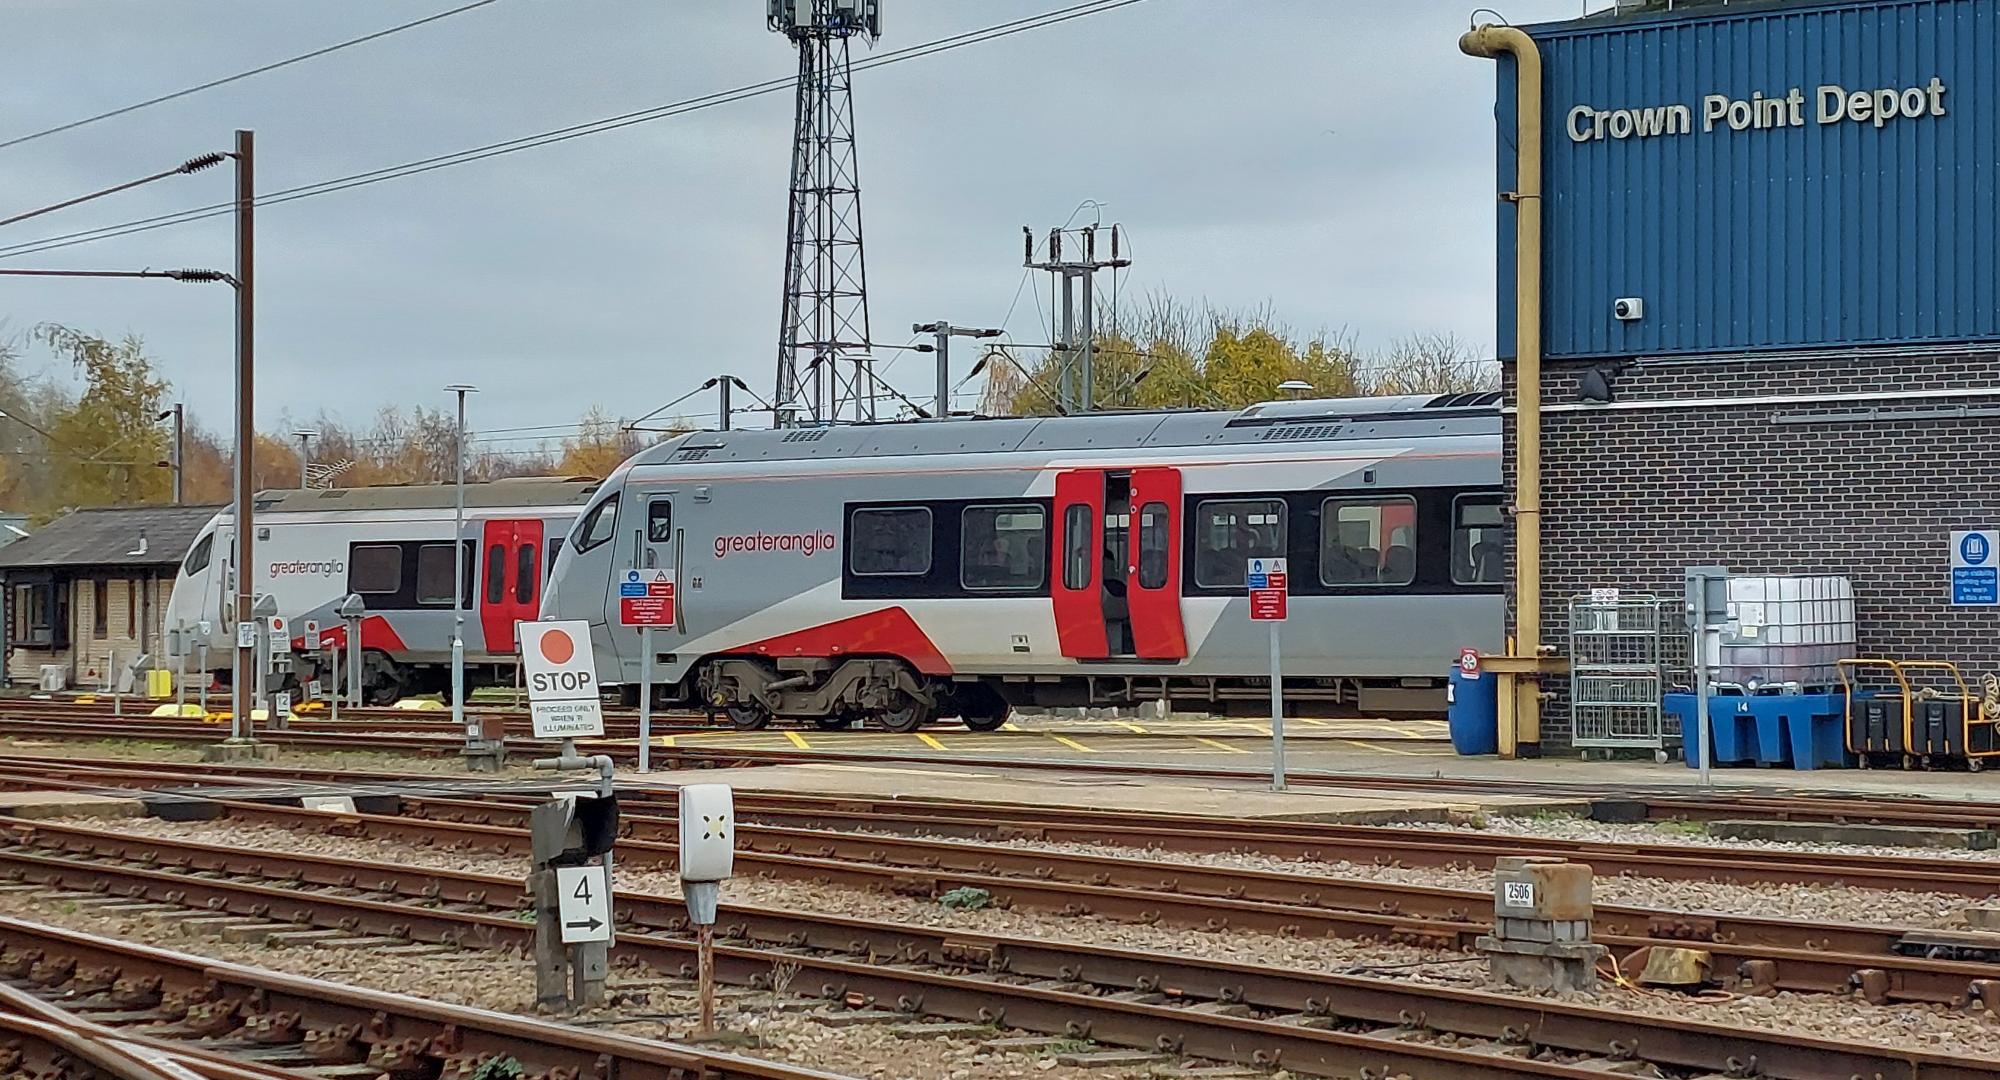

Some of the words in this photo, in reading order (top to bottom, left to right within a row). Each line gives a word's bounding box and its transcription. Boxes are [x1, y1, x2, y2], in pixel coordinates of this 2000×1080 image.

[1566, 104, 1691, 143] Crown
[1703, 88, 1805, 133] Point
[1816, 77, 1946, 128] Depot
[714, 529, 835, 558] greateranglia
[270, 559, 344, 578] greateranglia
[532, 671, 591, 692] STOP
[536, 705, 573, 713] PROCEED
[574, 704, 595, 712] ONLY
[550, 714, 574, 722] WHEN
[542, 723, 595, 732] ILLUMINATED
[573, 875, 593, 905] 4
[1508, 884, 1530, 900] 2506
